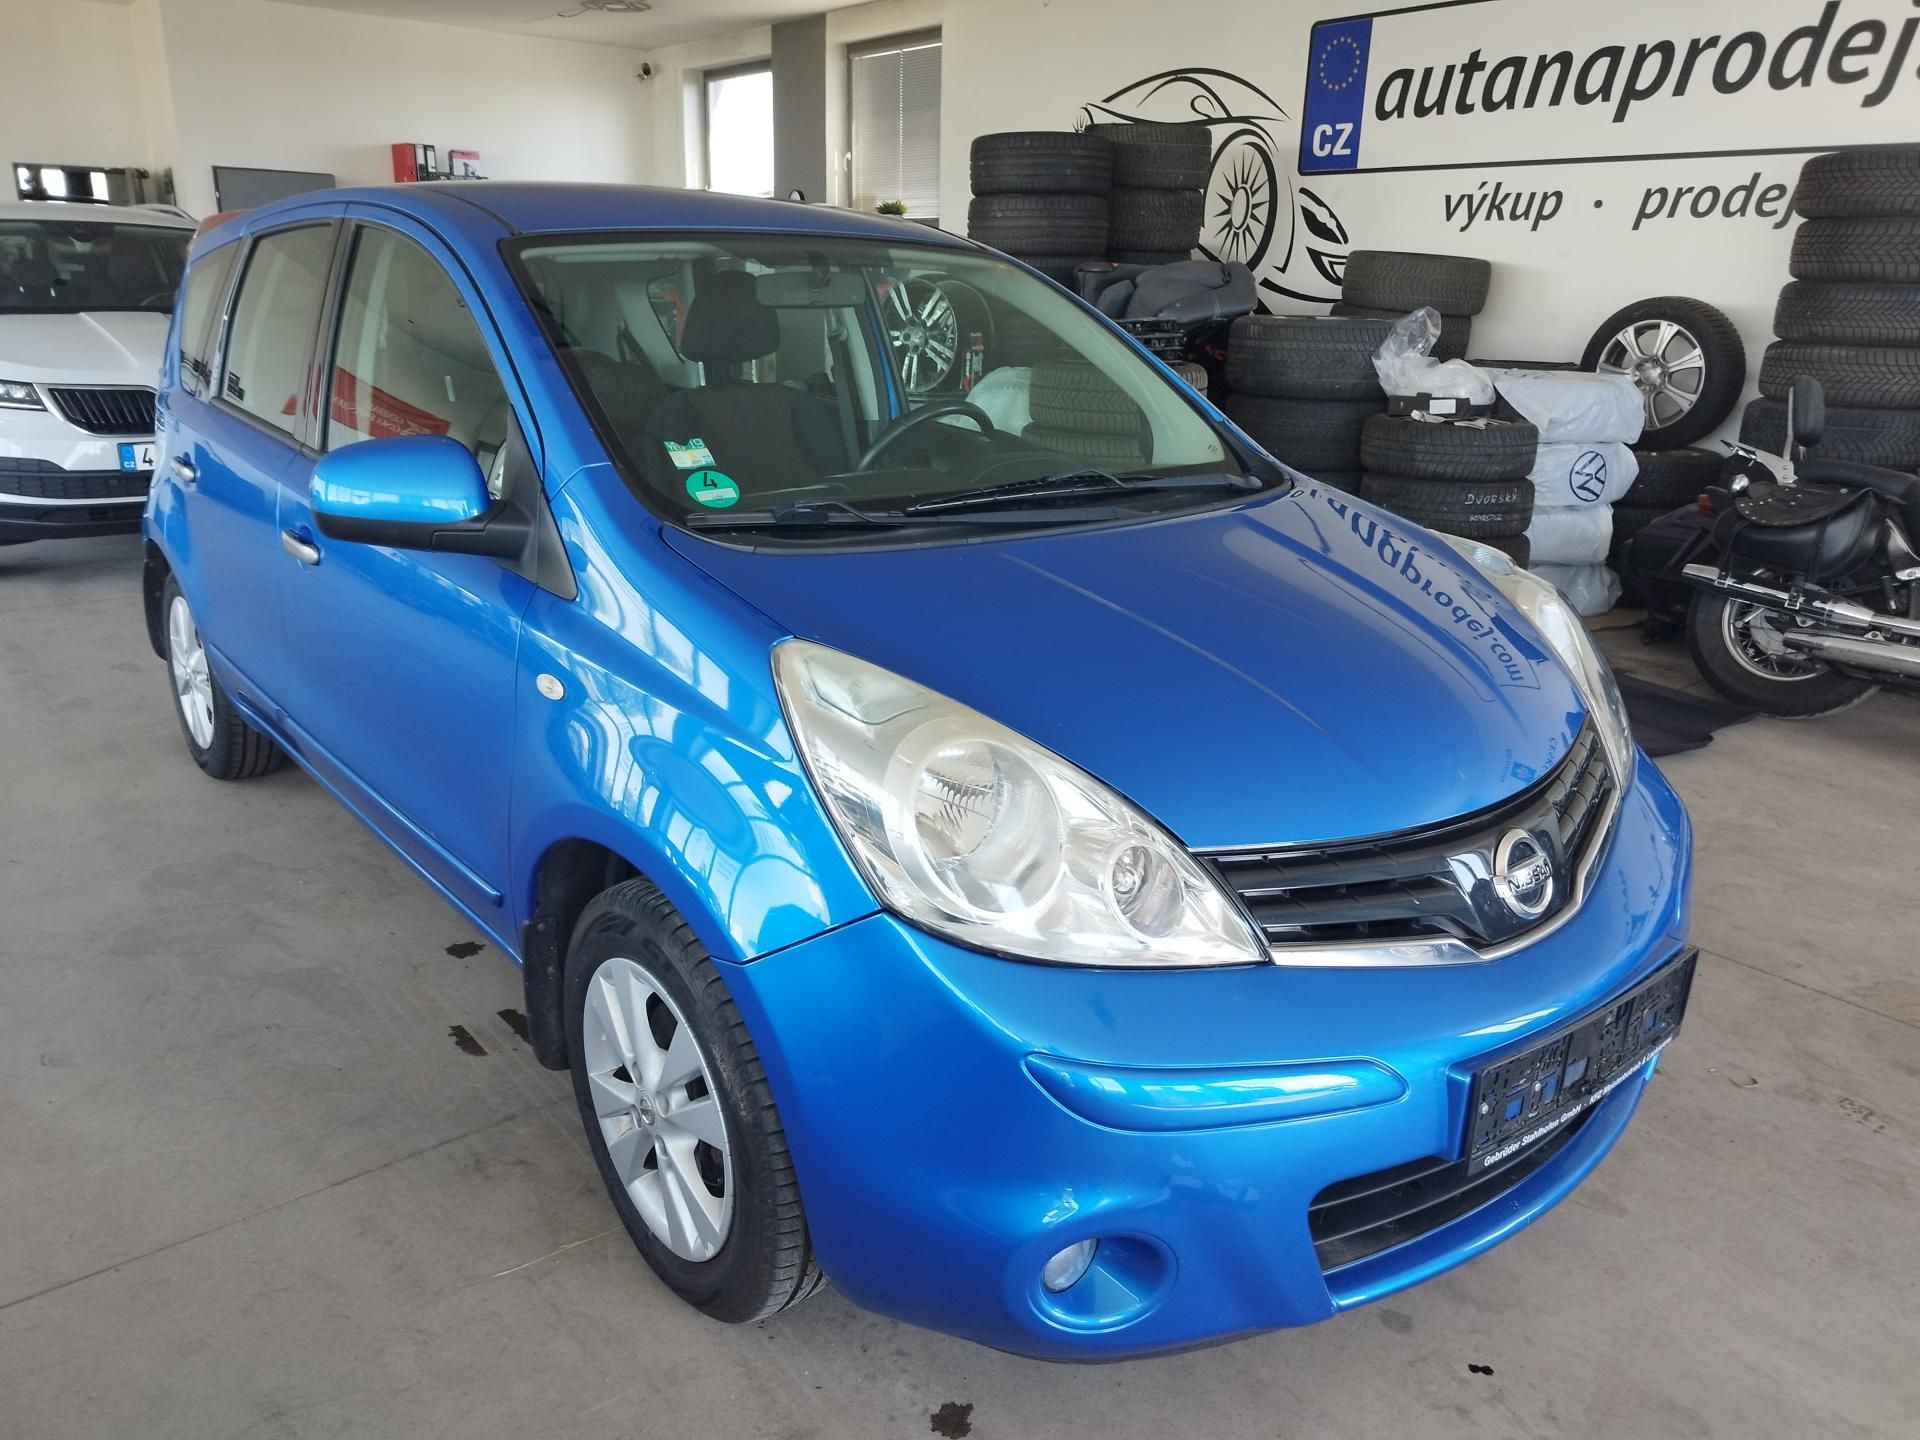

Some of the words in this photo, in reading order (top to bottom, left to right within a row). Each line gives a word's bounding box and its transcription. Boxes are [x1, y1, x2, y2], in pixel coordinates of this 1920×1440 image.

[1374, 0, 1920, 123] autanaprodej
[1312, 122, 1354, 157] CZ
[1444, 181, 1563, 232] výkup
[703, 472, 718, 488] 4
